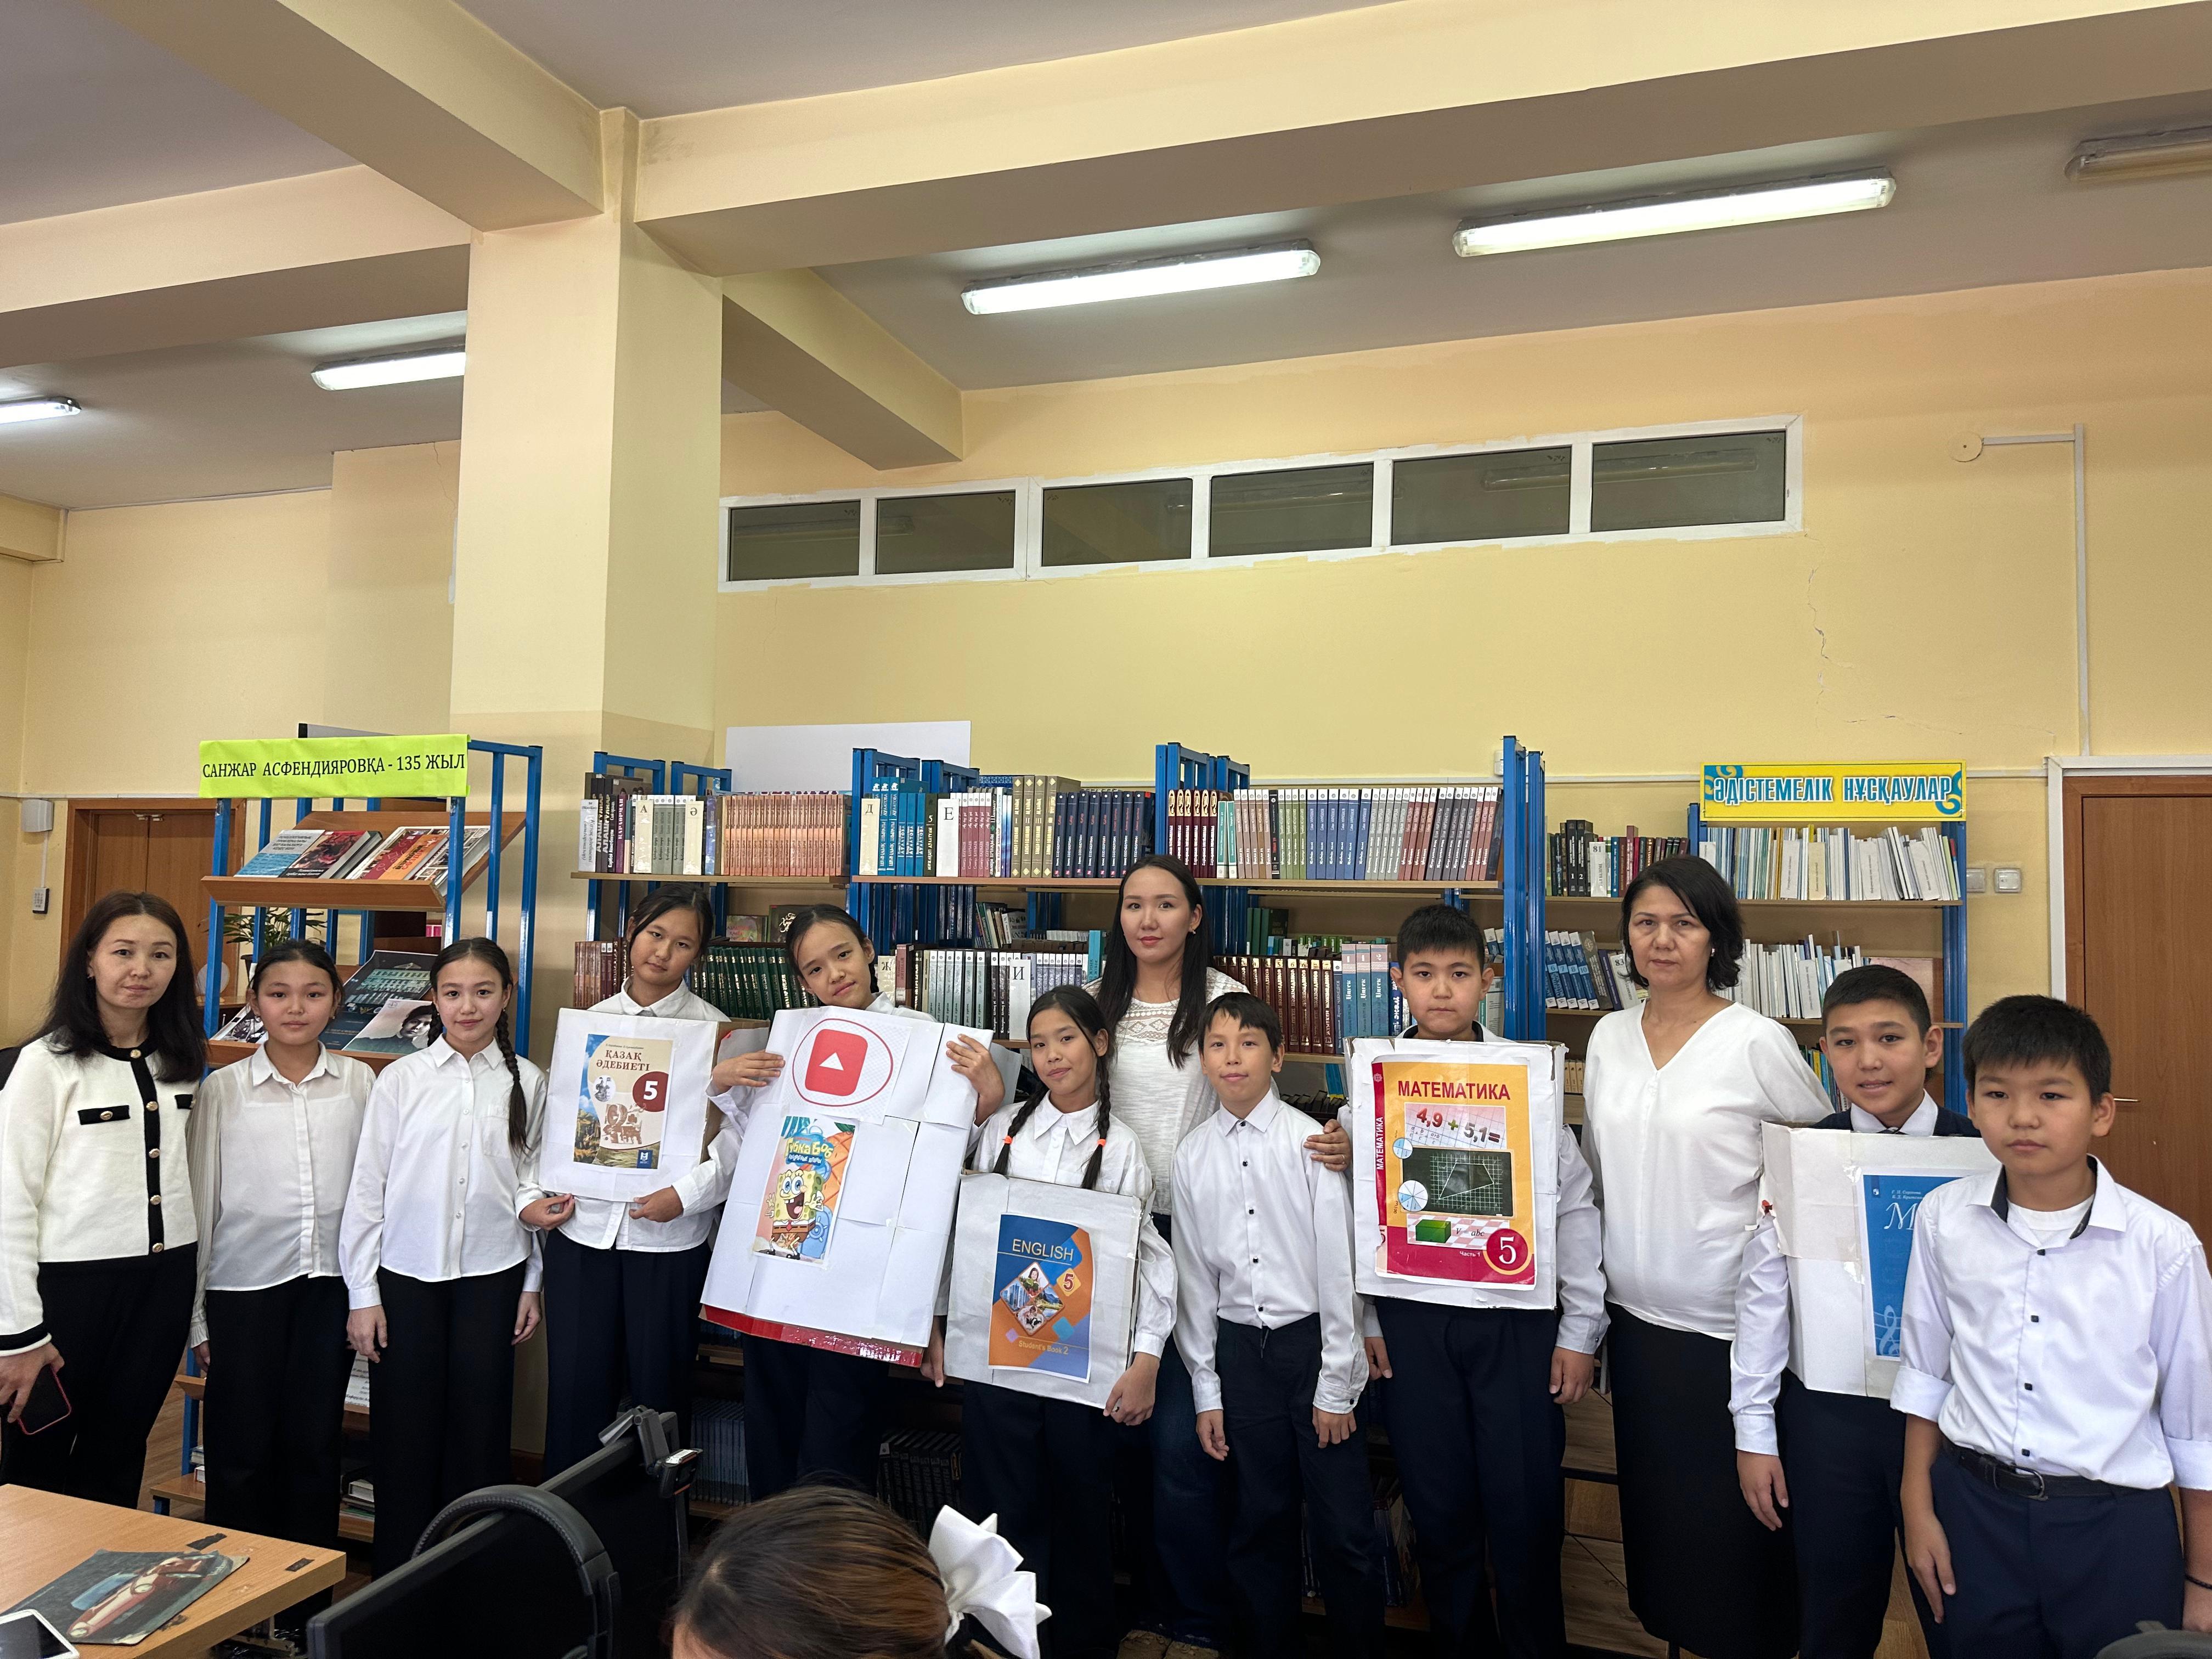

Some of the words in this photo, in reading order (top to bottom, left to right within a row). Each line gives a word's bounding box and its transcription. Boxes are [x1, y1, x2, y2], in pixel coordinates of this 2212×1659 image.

[203, 763, 257, 777] САНЖАР
[262, 757, 385, 778] АСФЕНДИЯРОВҚА
[397, 755, 421, 771] 135
[425, 754, 465, 769] ЖЫЛ
[1713, 777, 1833, 805] ӘДІСТЕМЕЛІК
[1842, 776, 1954, 805] НҰСҚАУЛАР
[640, 805, 648, 813] А
[690, 808, 698, 816] Ә
[865, 804, 873, 815] Д
[1012, 967, 1025, 980] И
[605, 1049, 642, 1061] ҚАЗАҚ
[596, 1060, 650, 1071] ӘДЕБИЕТІ
[643, 1080, 658, 1101] 5
[1398, 1080, 1511, 1101] МАТЕМАТИКА
[1416, 1107, 1443, 1127] 4,9
[1376, 1116, 1384, 1170] МАТЕМАТИКА
[1471, 1228, 1485, 1237] abc
[1012, 1238, 1074, 1261] ENGLISH
[1499, 1236, 1517, 1264] 5
[1063, 1273, 1075, 1290] 5
[1018, 1340, 1046, 1352] Student's
[1063, 1346, 1069, 1355] 2
